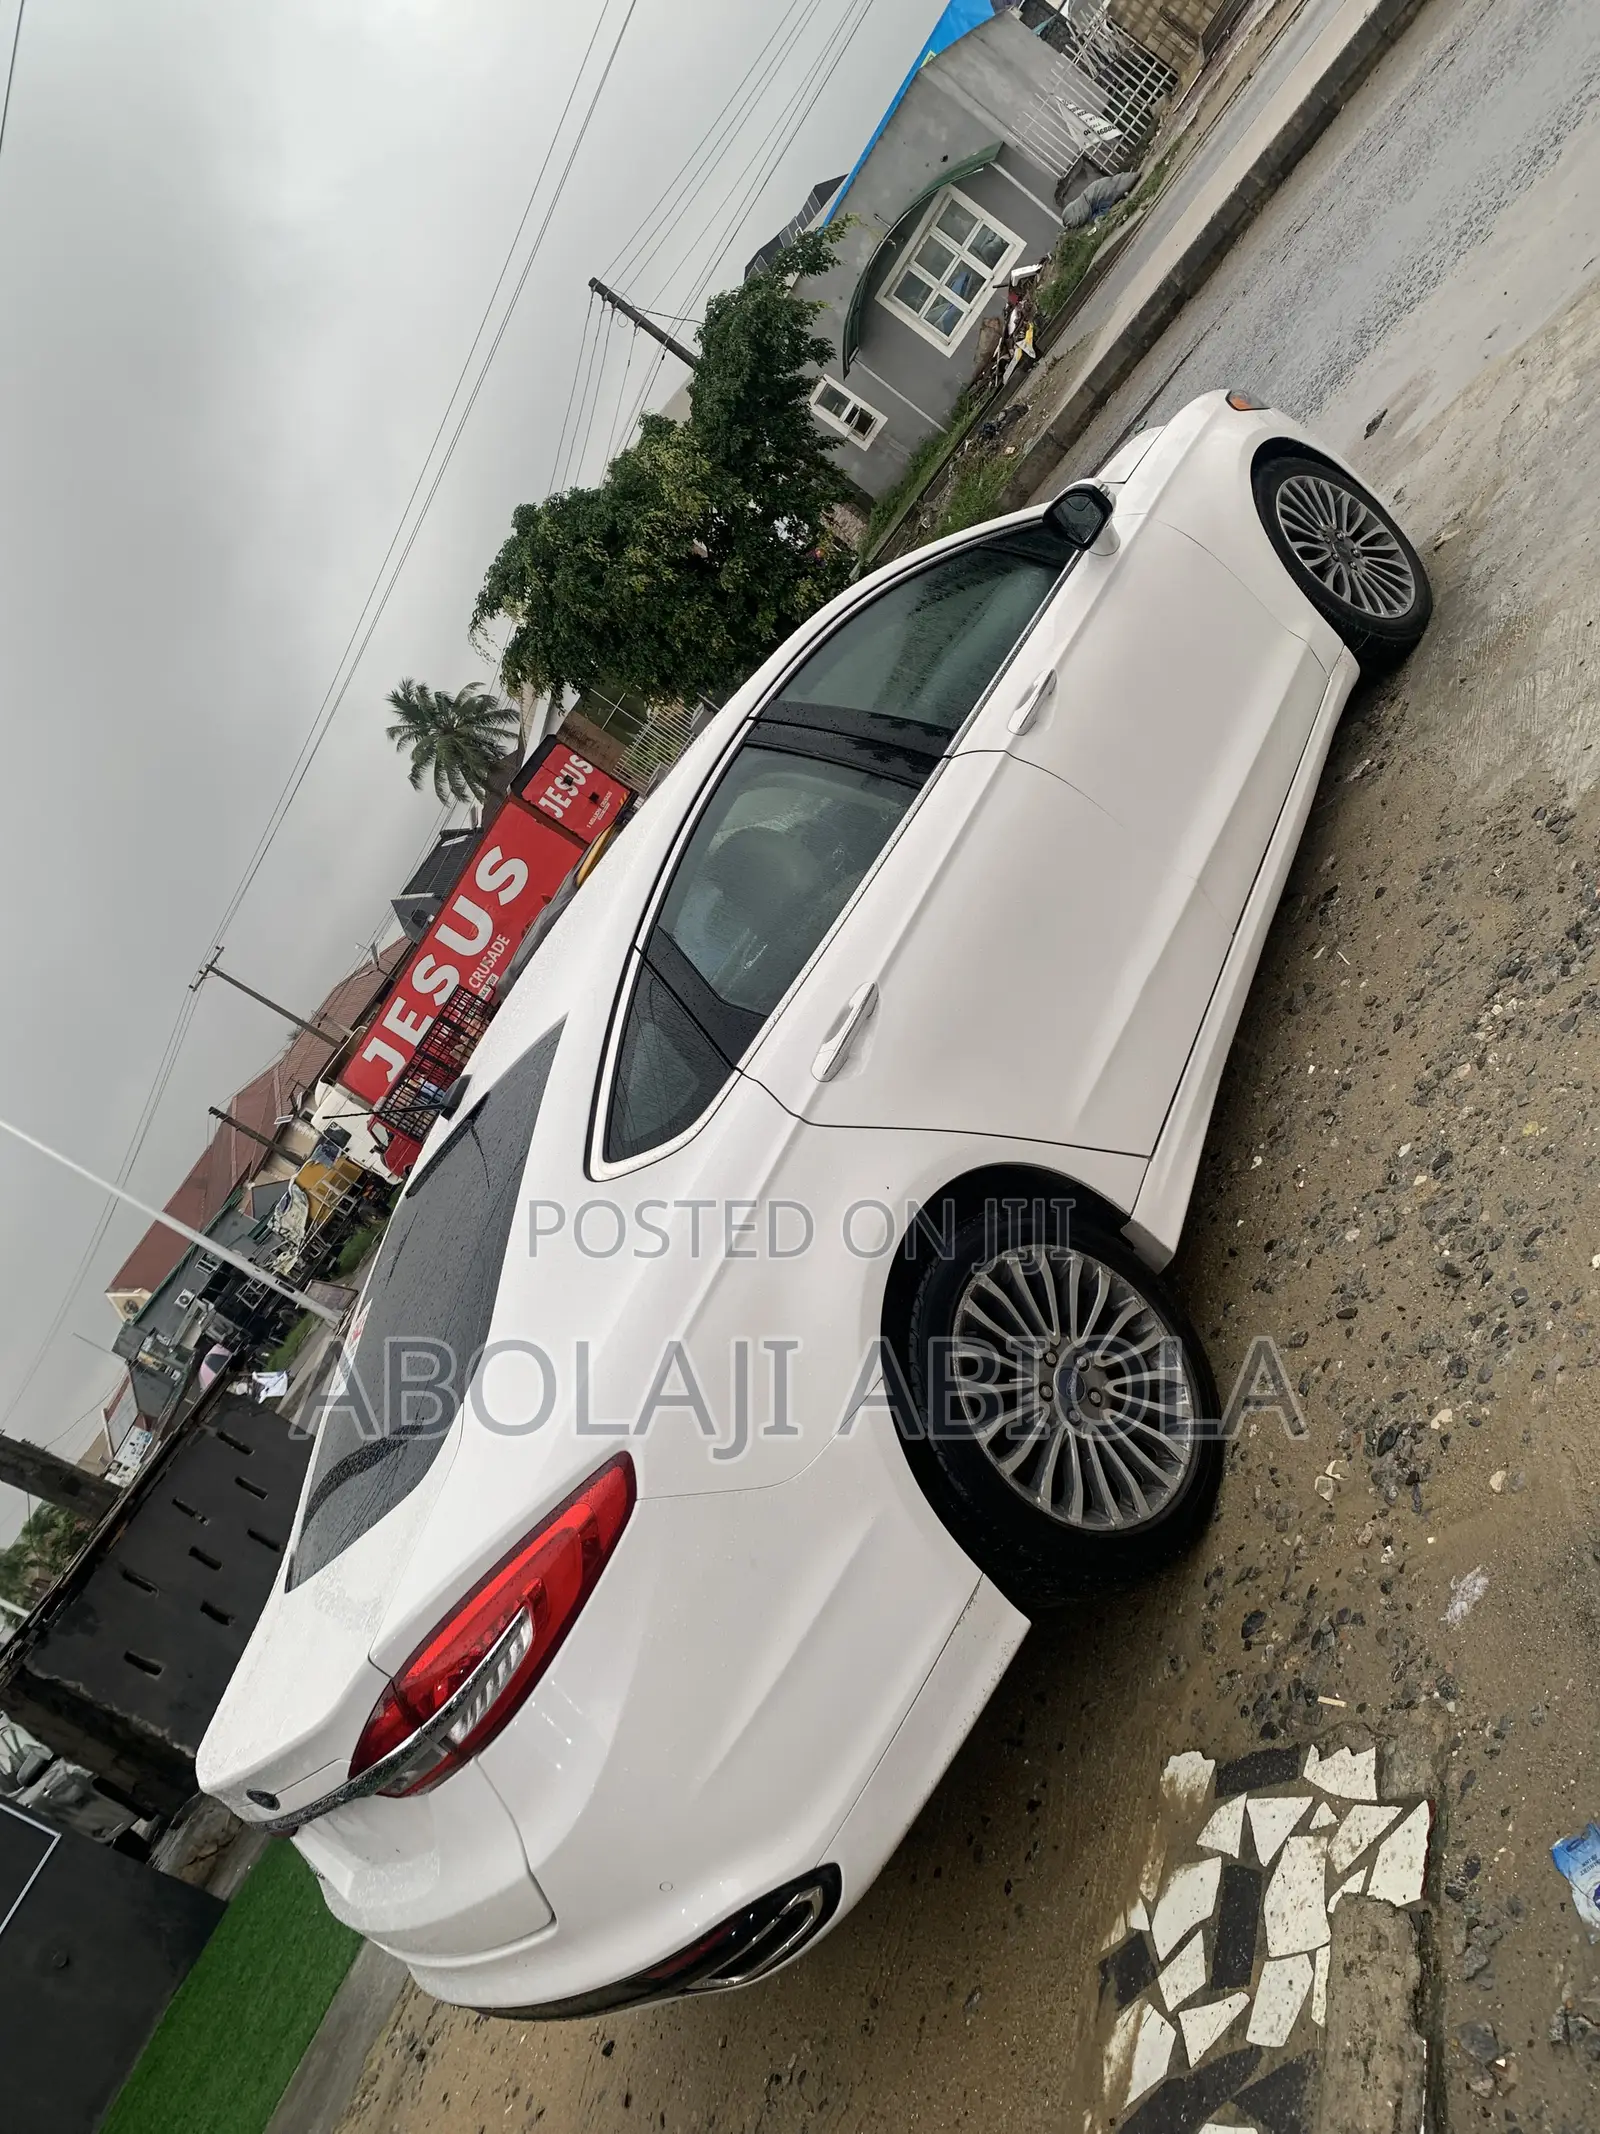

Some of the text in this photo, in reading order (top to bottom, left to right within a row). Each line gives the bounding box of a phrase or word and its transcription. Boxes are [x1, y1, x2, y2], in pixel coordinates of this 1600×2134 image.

[538, 754, 594, 819] JESUS
[362, 845, 529, 1083] JESUS
[468, 933, 511, 990] CRUSADE
